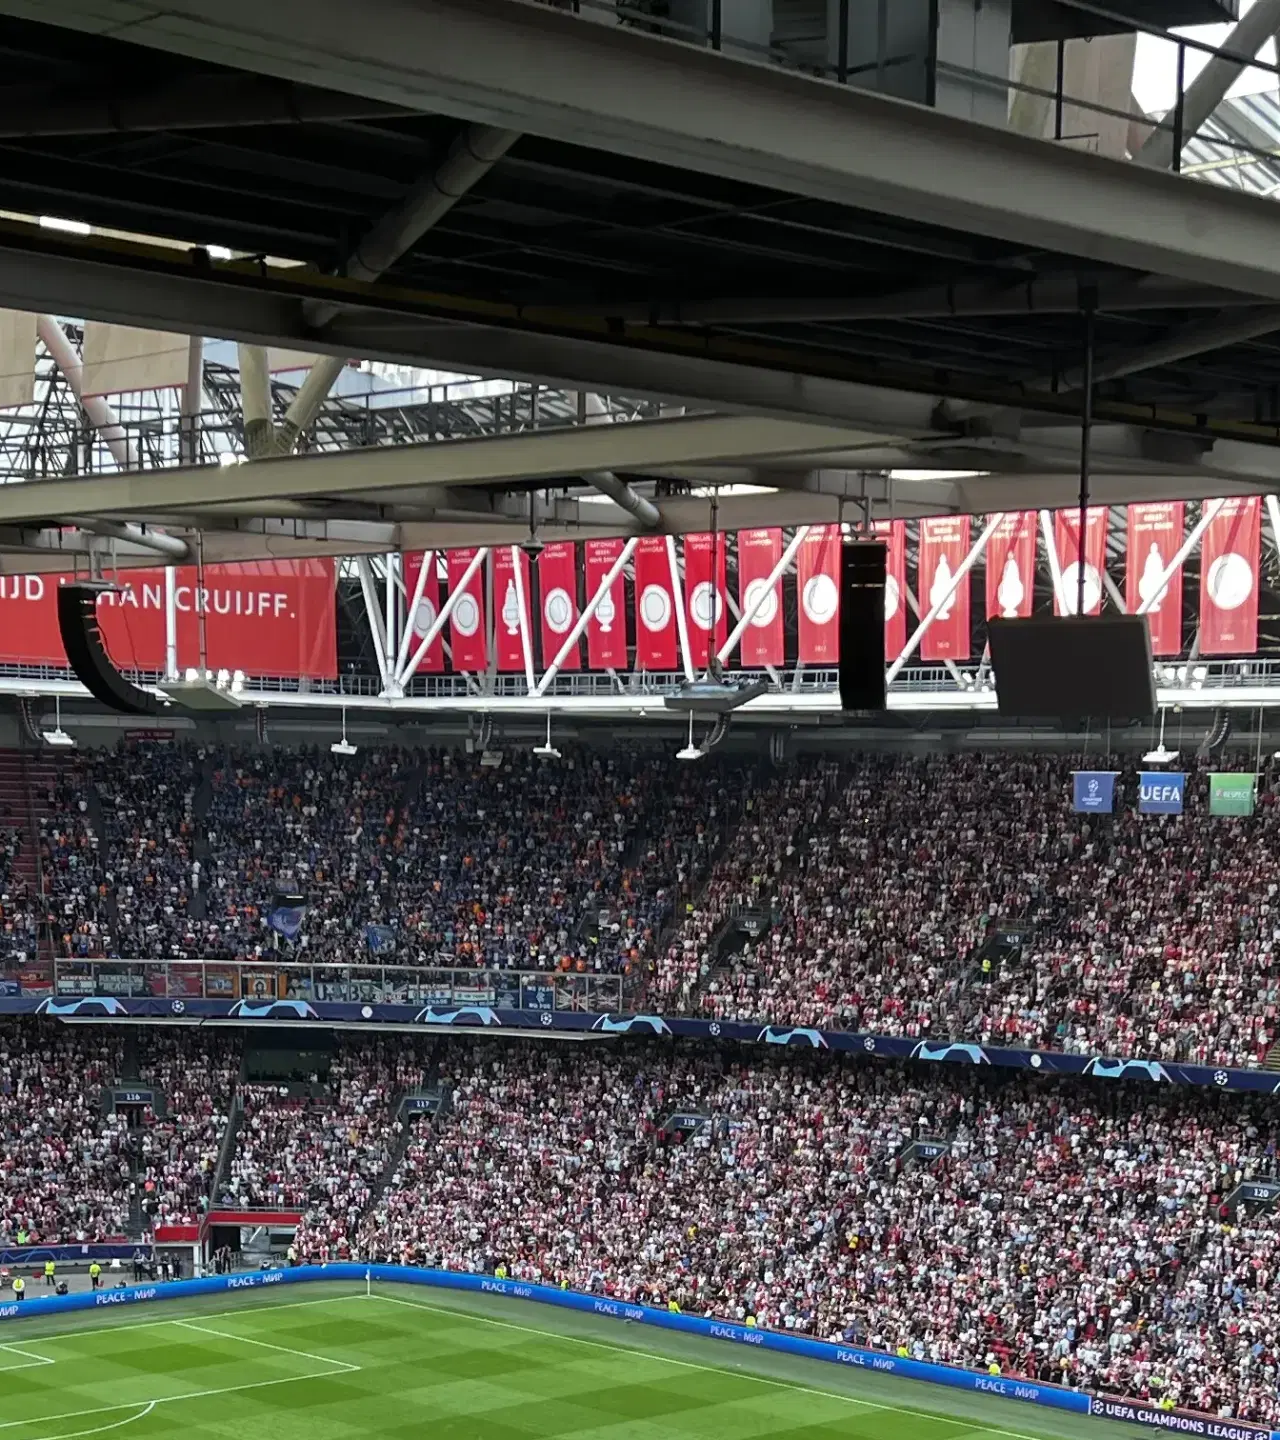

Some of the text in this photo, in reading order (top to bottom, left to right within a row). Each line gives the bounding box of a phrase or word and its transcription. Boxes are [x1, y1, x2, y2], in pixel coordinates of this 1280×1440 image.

[1140, 786, 1180, 801] UEFA
[227, 1276, 254, 1287] PEACE
[481, 1281, 506, 1293] PEACE
[96, 1293, 125, 1304] PEACE
[594, 1301, 618, 1314] PEACE
[710, 1326, 736, 1338] PEACE
[837, 1351, 864, 1365] PEACE
[975, 1379, 1006, 1394] PEACE
[1105, 1403, 1135, 1419] UEFA
[1137, 1410, 1204, 1433] CHAMPIONS
